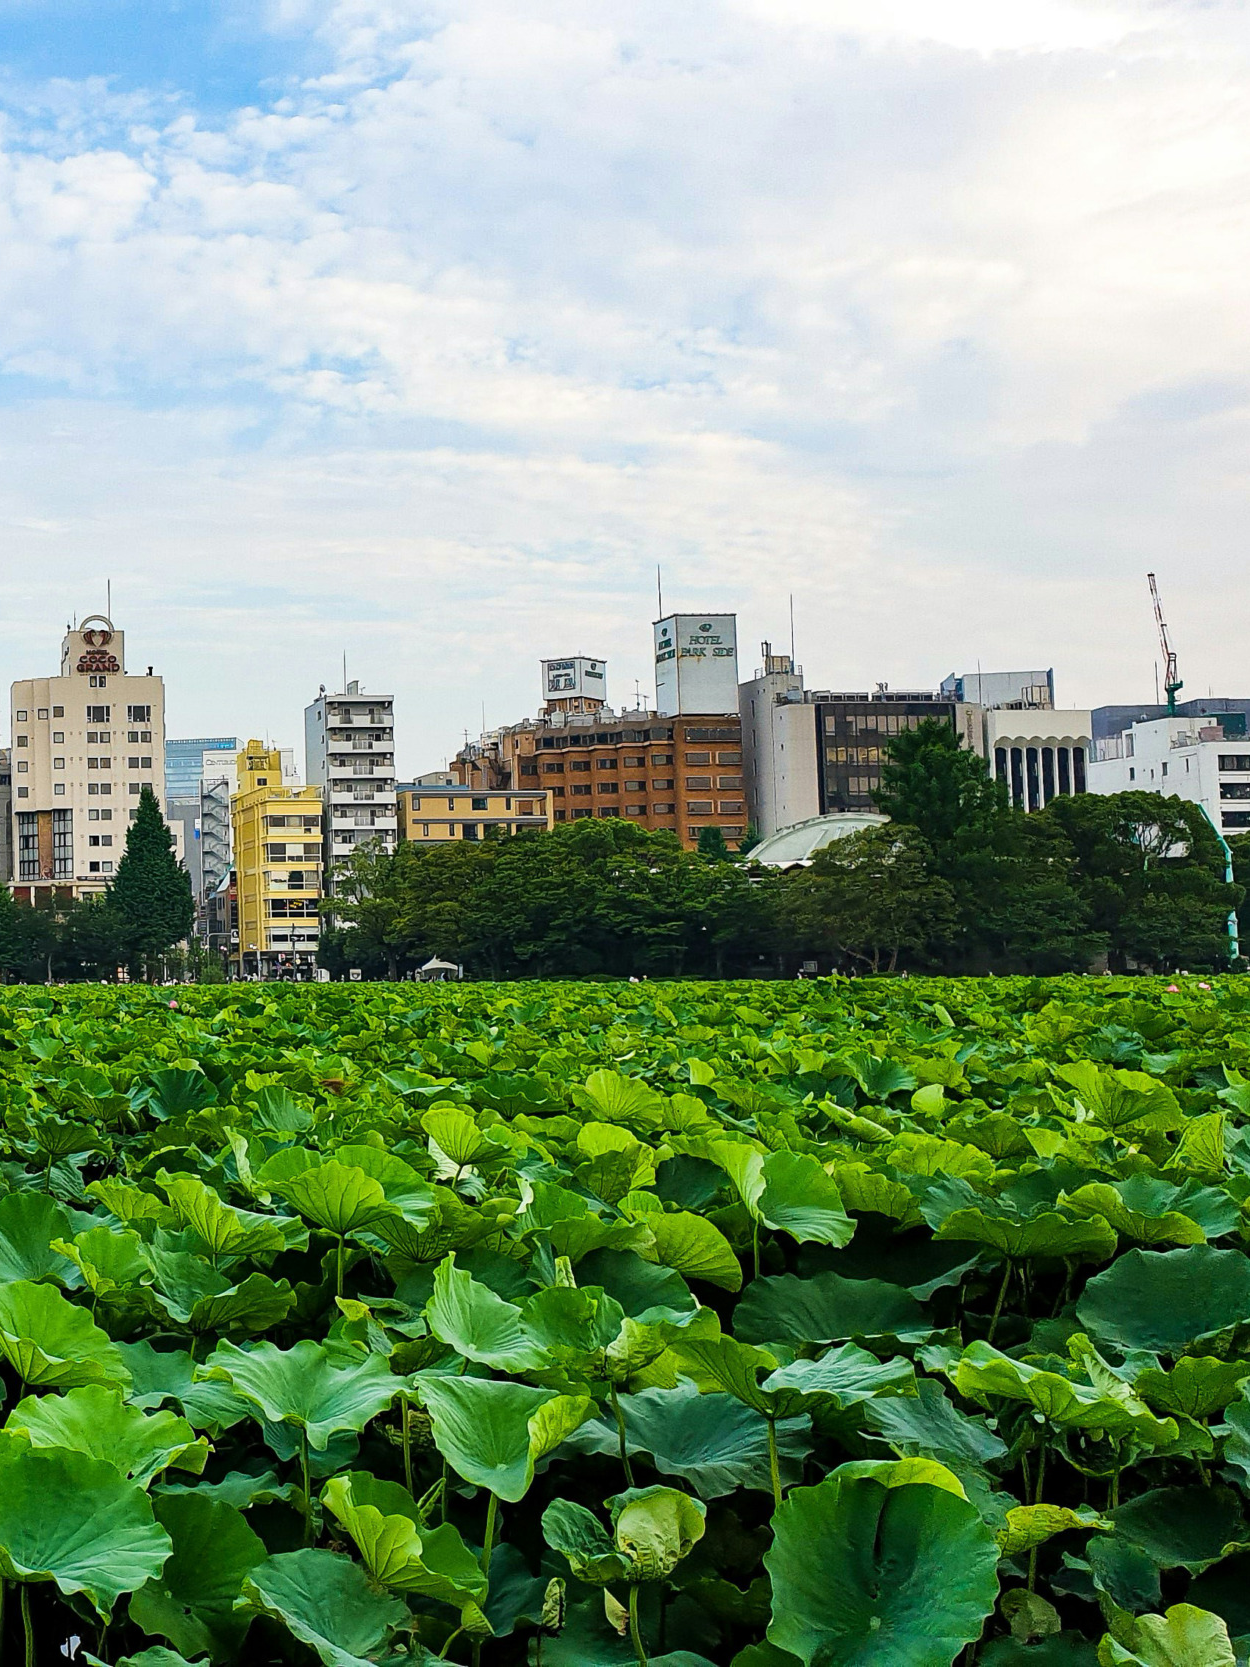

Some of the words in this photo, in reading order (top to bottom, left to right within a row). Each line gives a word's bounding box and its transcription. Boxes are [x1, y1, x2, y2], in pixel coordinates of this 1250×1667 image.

[689, 635, 723, 645] HOTEL
[681, 647, 707, 657] PARK
[712, 647, 735, 657] SIDE
[79, 655, 117, 663] COCO
[76, 663, 120, 672] GRAND
